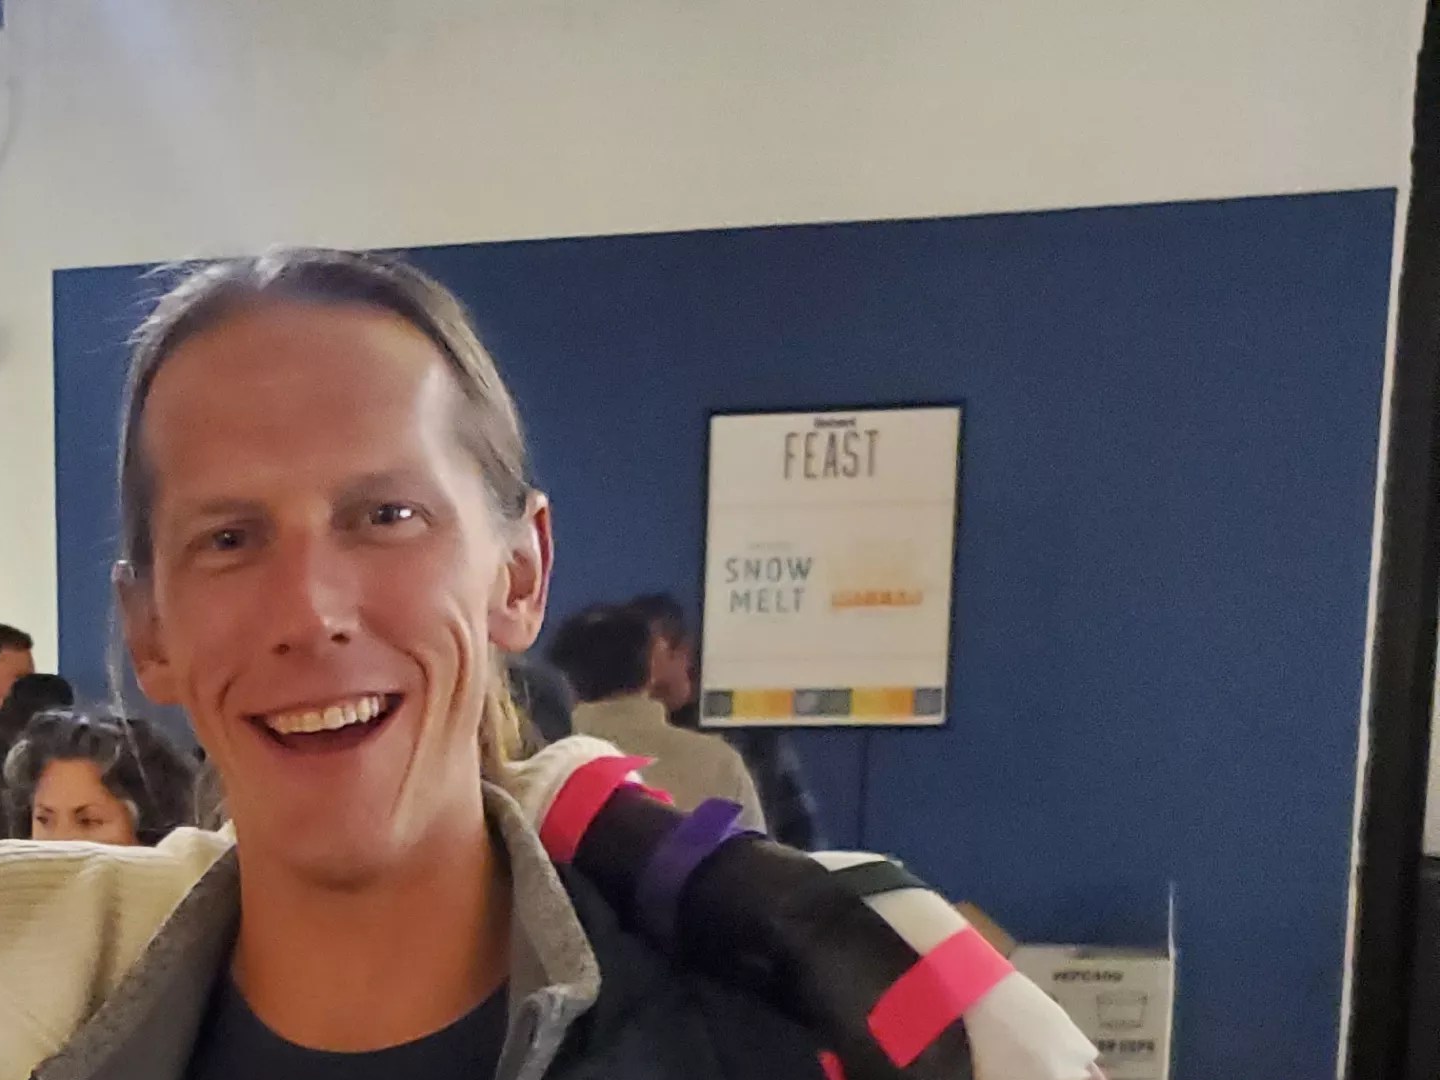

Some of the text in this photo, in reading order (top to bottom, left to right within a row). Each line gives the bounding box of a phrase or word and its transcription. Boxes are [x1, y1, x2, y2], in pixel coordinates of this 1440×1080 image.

[784, 430, 879, 479] FEAST
[725, 556, 812, 583] SNOW
[729, 588, 805, 613] MELT
